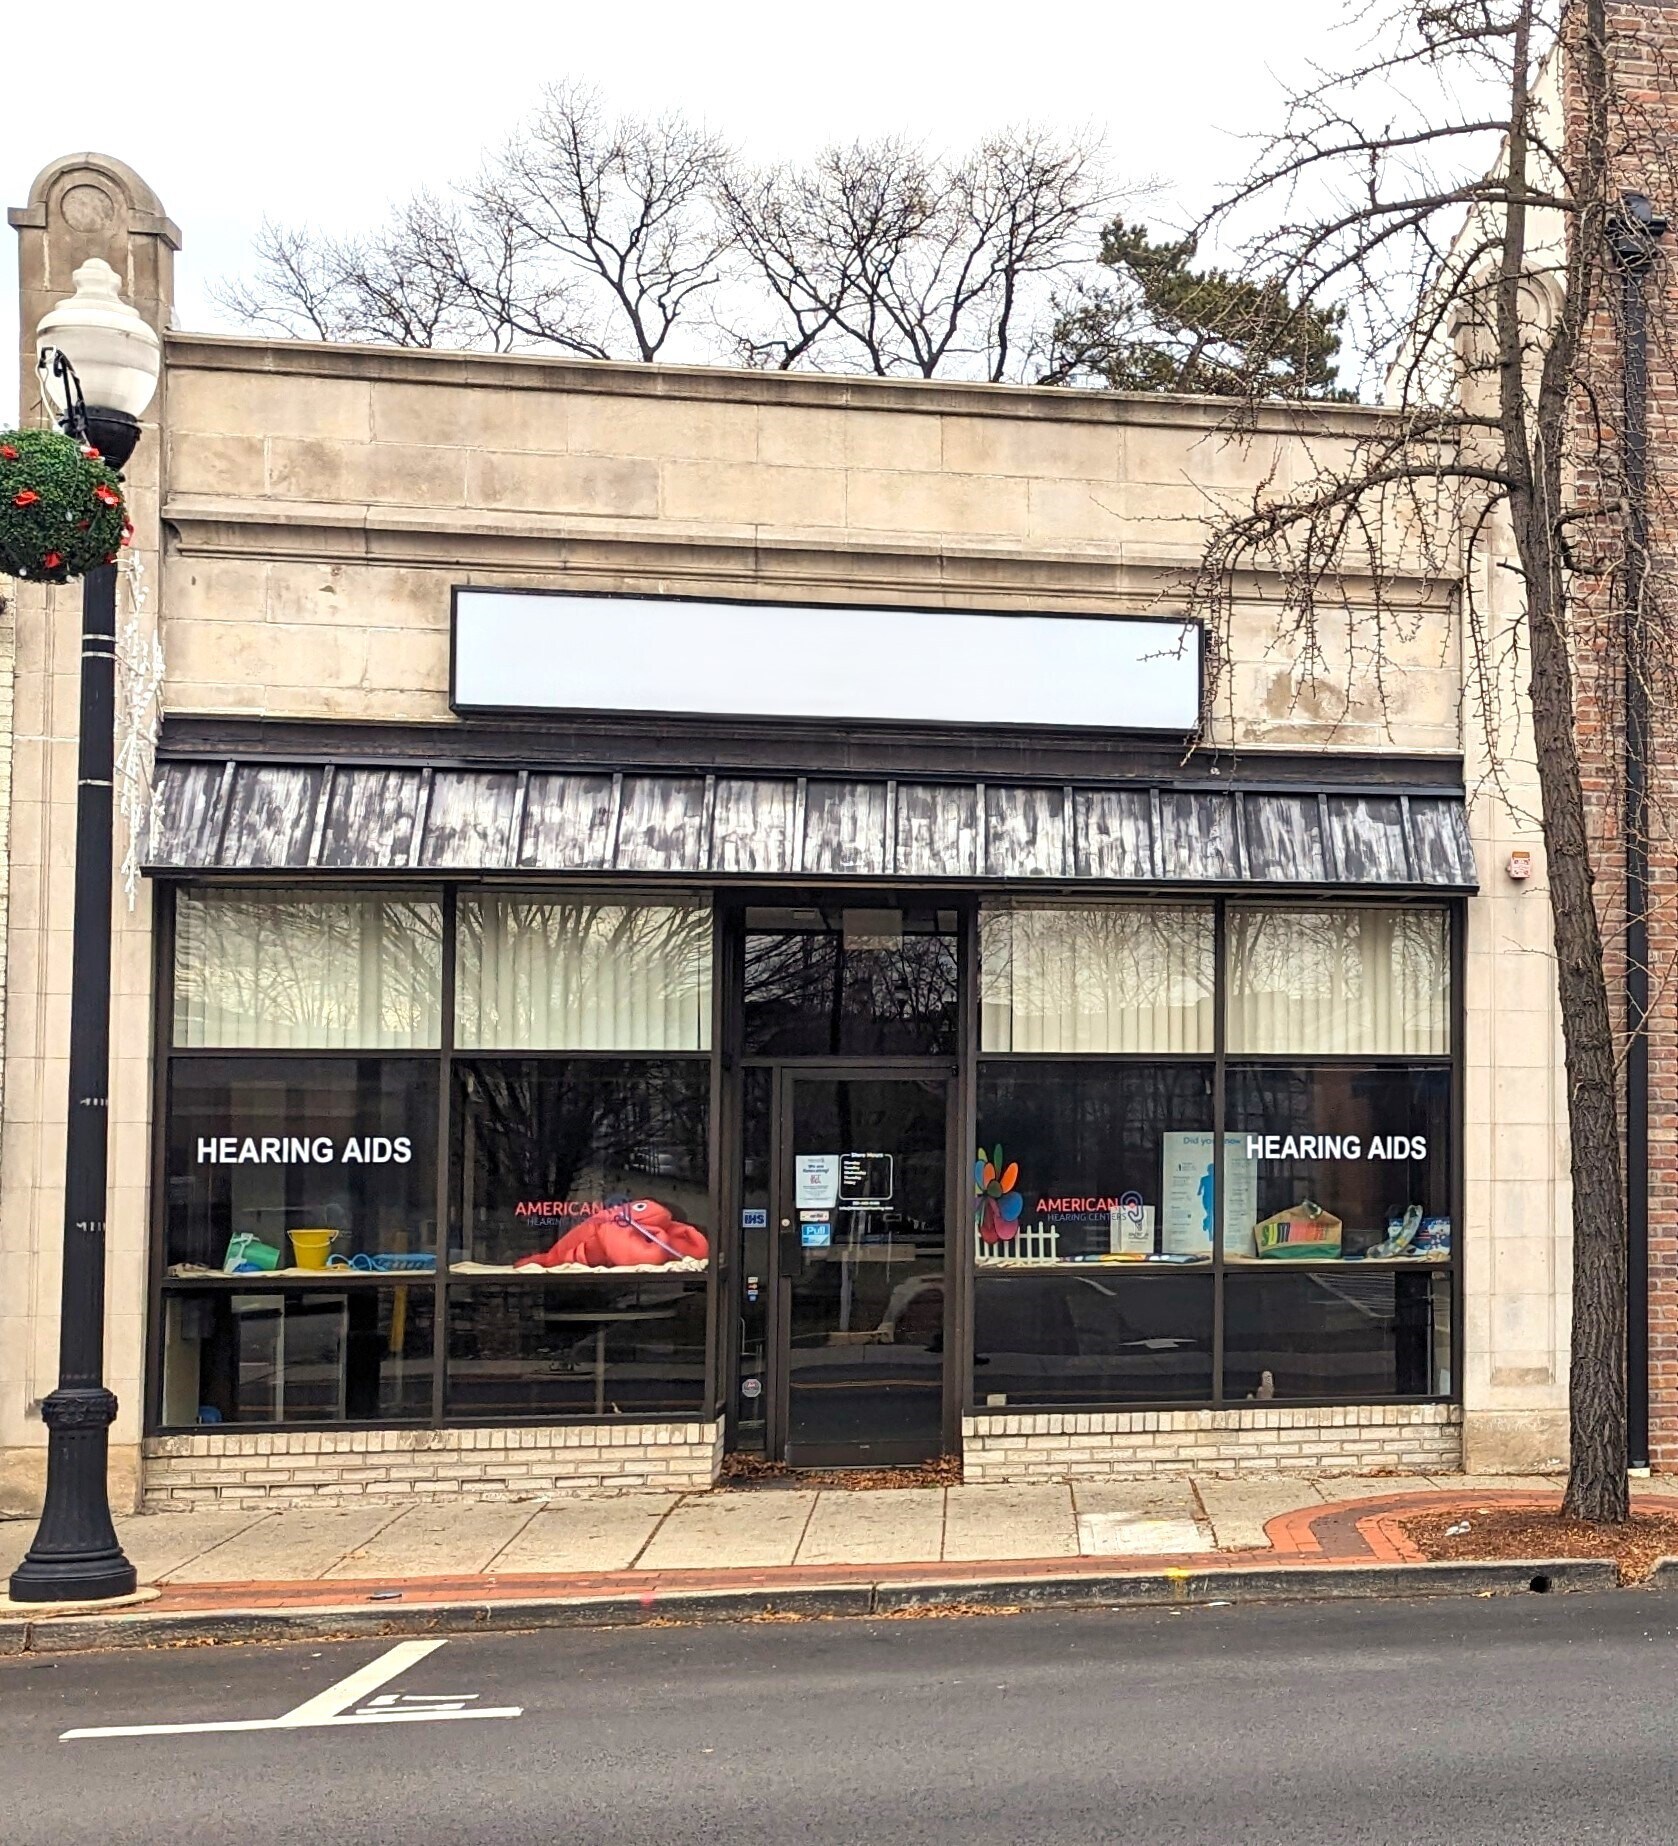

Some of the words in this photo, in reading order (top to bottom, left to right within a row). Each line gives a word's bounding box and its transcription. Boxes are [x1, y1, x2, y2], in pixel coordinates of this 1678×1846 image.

[1183, 1136, 1199, 1145] Did
[1246, 1135, 1361, 1160] HEARING
[1368, 1135, 1427, 1160] AIDS
[197, 1137, 334, 1164] HEARING
[342, 1137, 412, 1163] AIDS
[515, 1201, 605, 1217] AMERICAN
[1036, 1197, 1119, 1213] AMERICAN
[1047, 1213, 1087, 1222] HEARING
[1088, 1212, 1128, 1221] CENTERS
[806, 1226, 826, 1236] Pull
